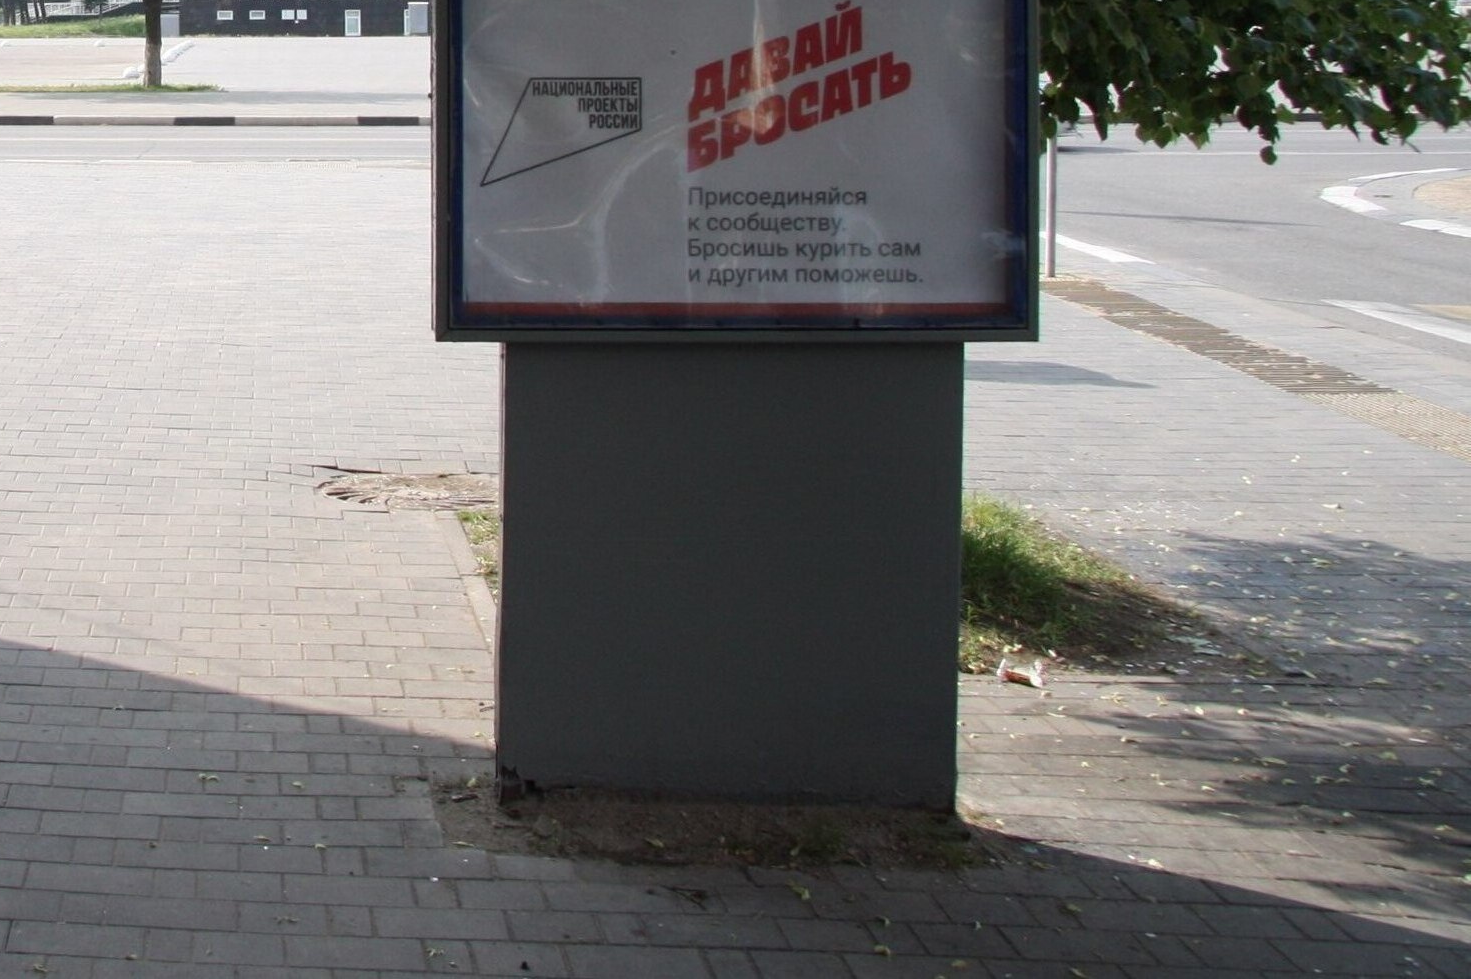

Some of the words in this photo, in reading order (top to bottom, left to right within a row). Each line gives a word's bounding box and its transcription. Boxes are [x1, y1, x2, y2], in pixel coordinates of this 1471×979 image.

[688, 0, 863, 122] ДАВАЙ
[532, 81, 638, 97] НАЦИОНАЛЬНЫЕ
[578, 98, 638, 112] ПРОЕКТЫ
[687, 51, 912, 173] БРОСАТЬ
[589, 114, 638, 129] РОССИИ
[688, 187, 867, 207] Присоединяйся
[688, 216, 700, 231] к
[688, 240, 789, 260] Бросишь
[795, 242, 871, 260] курить
[878, 243, 921, 257] сам
[689, 269, 701, 283] и
[707, 269, 787, 287] другим
[795, 269, 923, 283] поможешь.
